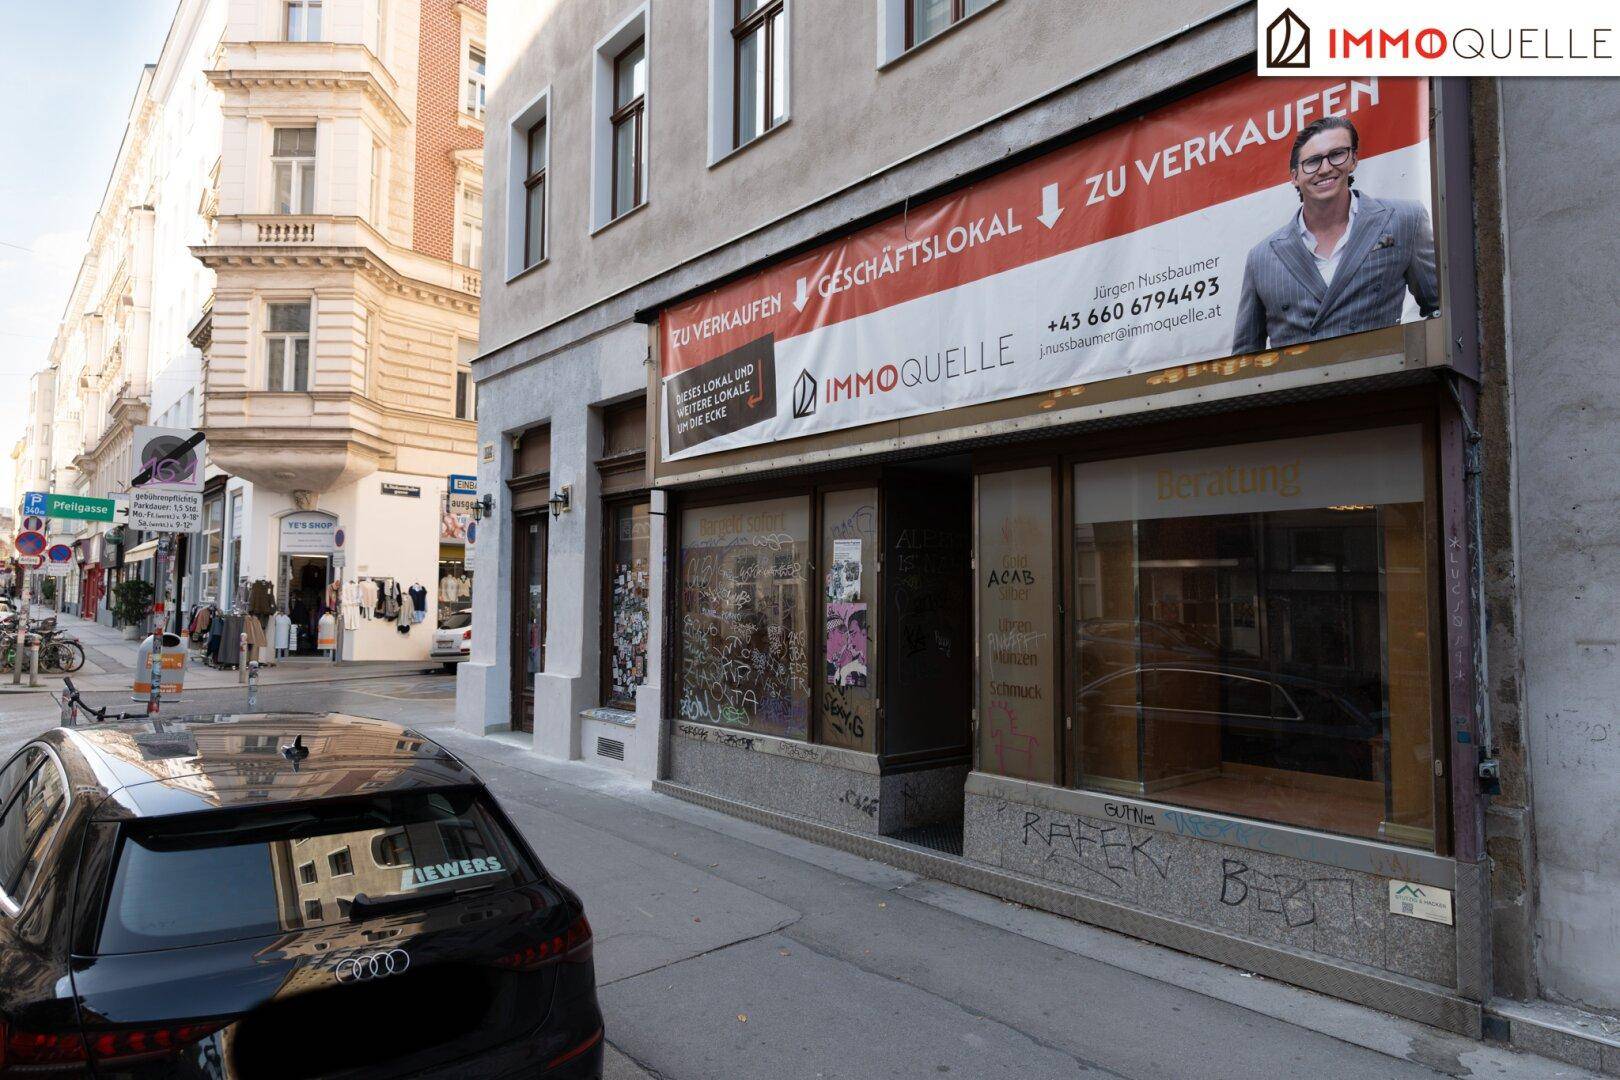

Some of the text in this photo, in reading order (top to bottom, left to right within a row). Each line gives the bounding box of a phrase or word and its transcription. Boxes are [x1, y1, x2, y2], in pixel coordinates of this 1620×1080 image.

[1085, 76, 1380, 207] ZU VERKAUFEN
[818, 208, 1023, 298] GESCHÄFTSLOKAL
[1092, 256, 1220, 301] Jürgen Nussbaumer
[1047, 276, 1221, 332] +43 660 6794493
[672, 292, 782, 348] ZU VERKAUFEN
[1039, 304, 1222, 360] j.nussbaumer@immoquelle.at
[675, 363, 754, 405] DIESES LOKAL UND
[676, 380, 751, 419] WEITERE LOKALE
[677, 406, 728, 434] UM DIE ECKE
[138, 457, 199, 483] 161
[1157, 460, 1303, 501] Beratung
[53, 500, 108, 514] Pfeilgasse
[133, 501, 199, 513] Parkdauer: 1,5 Std.
[135, 493, 198, 504] gebührenpflichtig
[451, 500, 475, 511] ausge
[699, 511, 785, 538] Bargeld sofort
[1002, 553, 1028, 569] Gold
[999, 586, 1031, 601] Silber
[998, 616, 1032, 634] Uhren
[992, 648, 1038, 667] Münzen
[989, 680, 1043, 700] Schmuck
